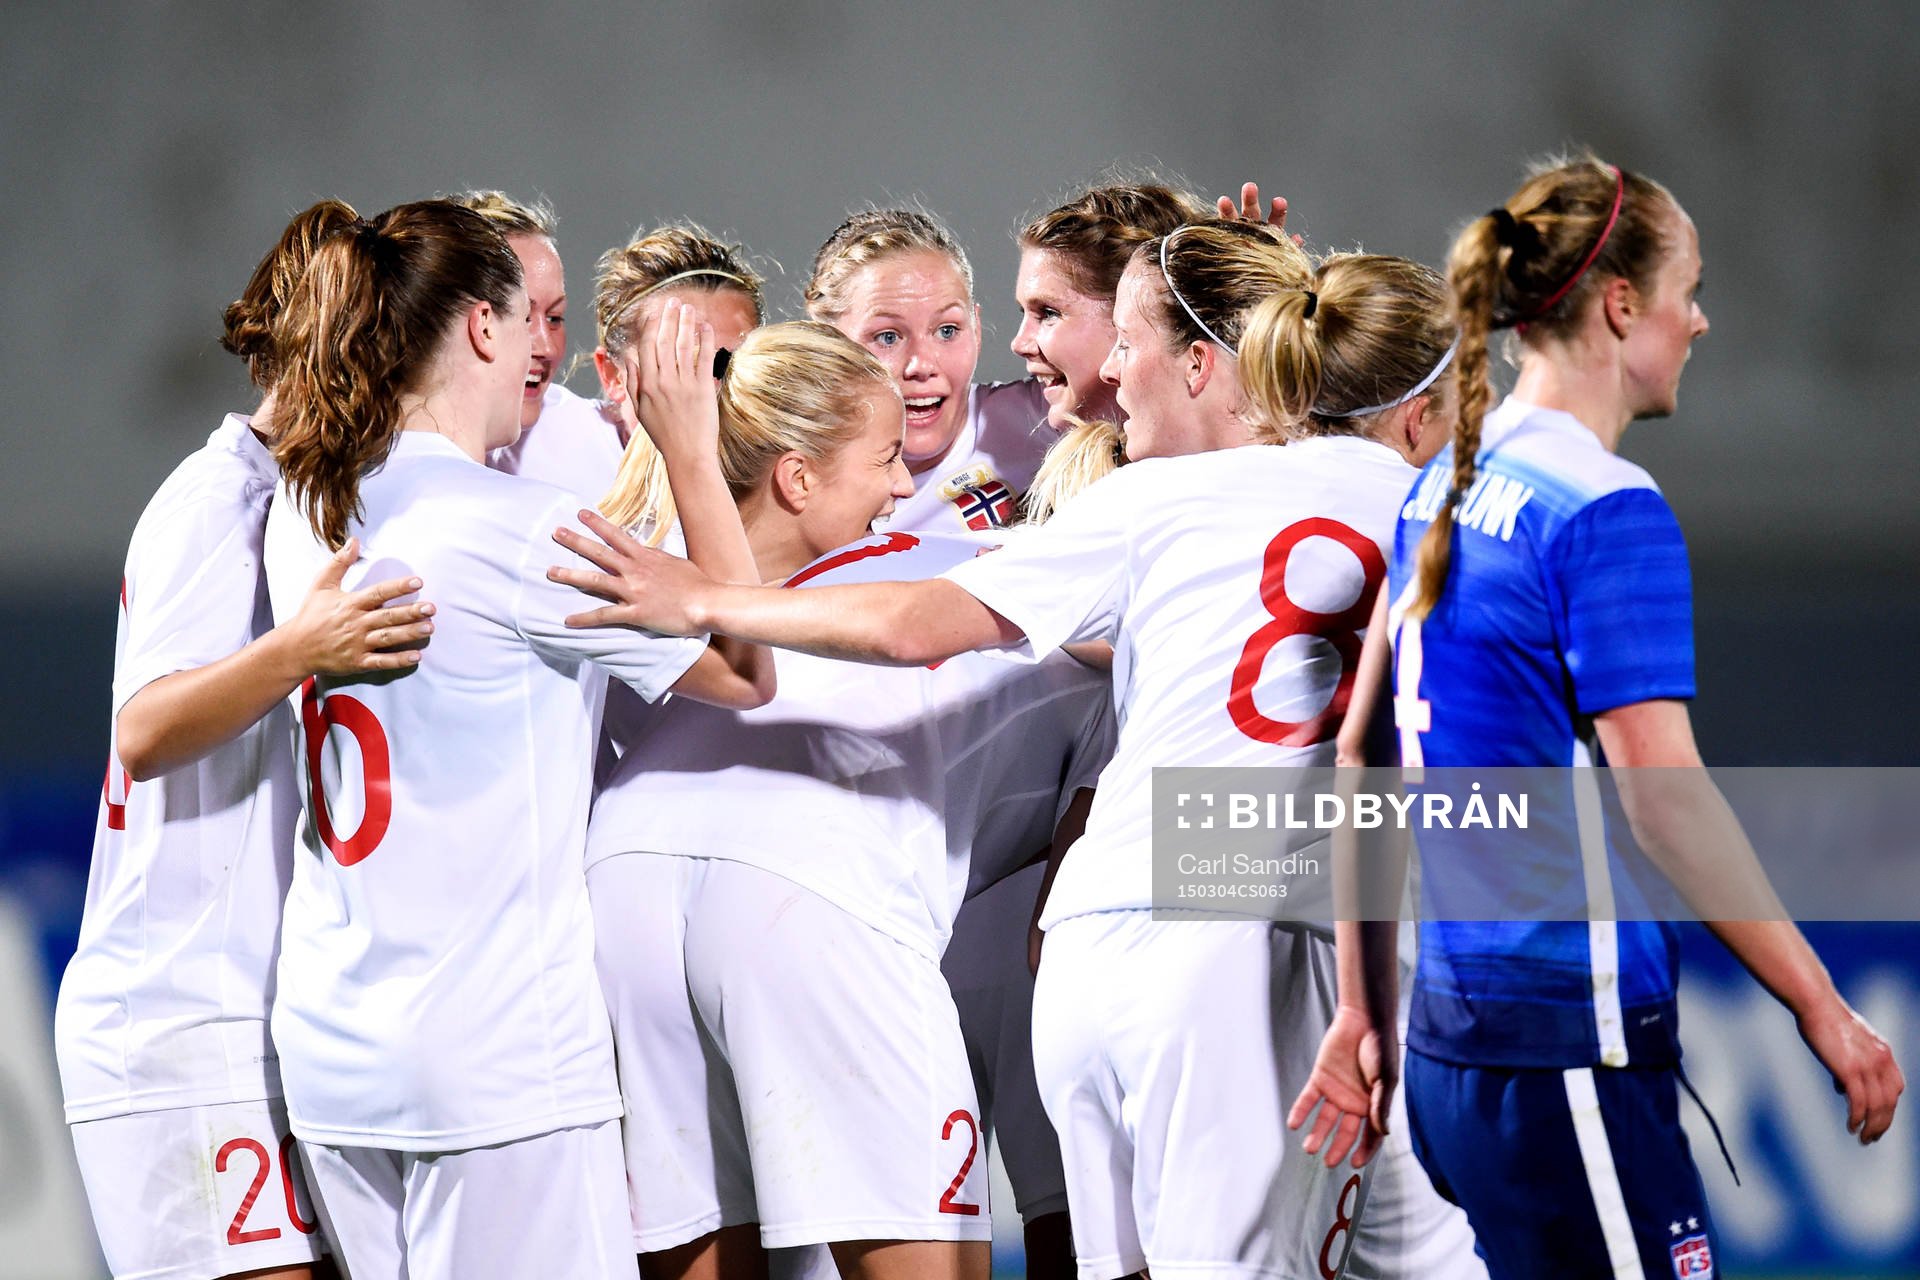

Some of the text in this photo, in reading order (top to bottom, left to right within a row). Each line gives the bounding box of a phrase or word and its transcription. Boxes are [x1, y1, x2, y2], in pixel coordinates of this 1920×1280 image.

[951, 472, 971, 487] NORGE
[1227, 517, 1387, 748] 8
[1319, 1174, 1360, 1280] 8
